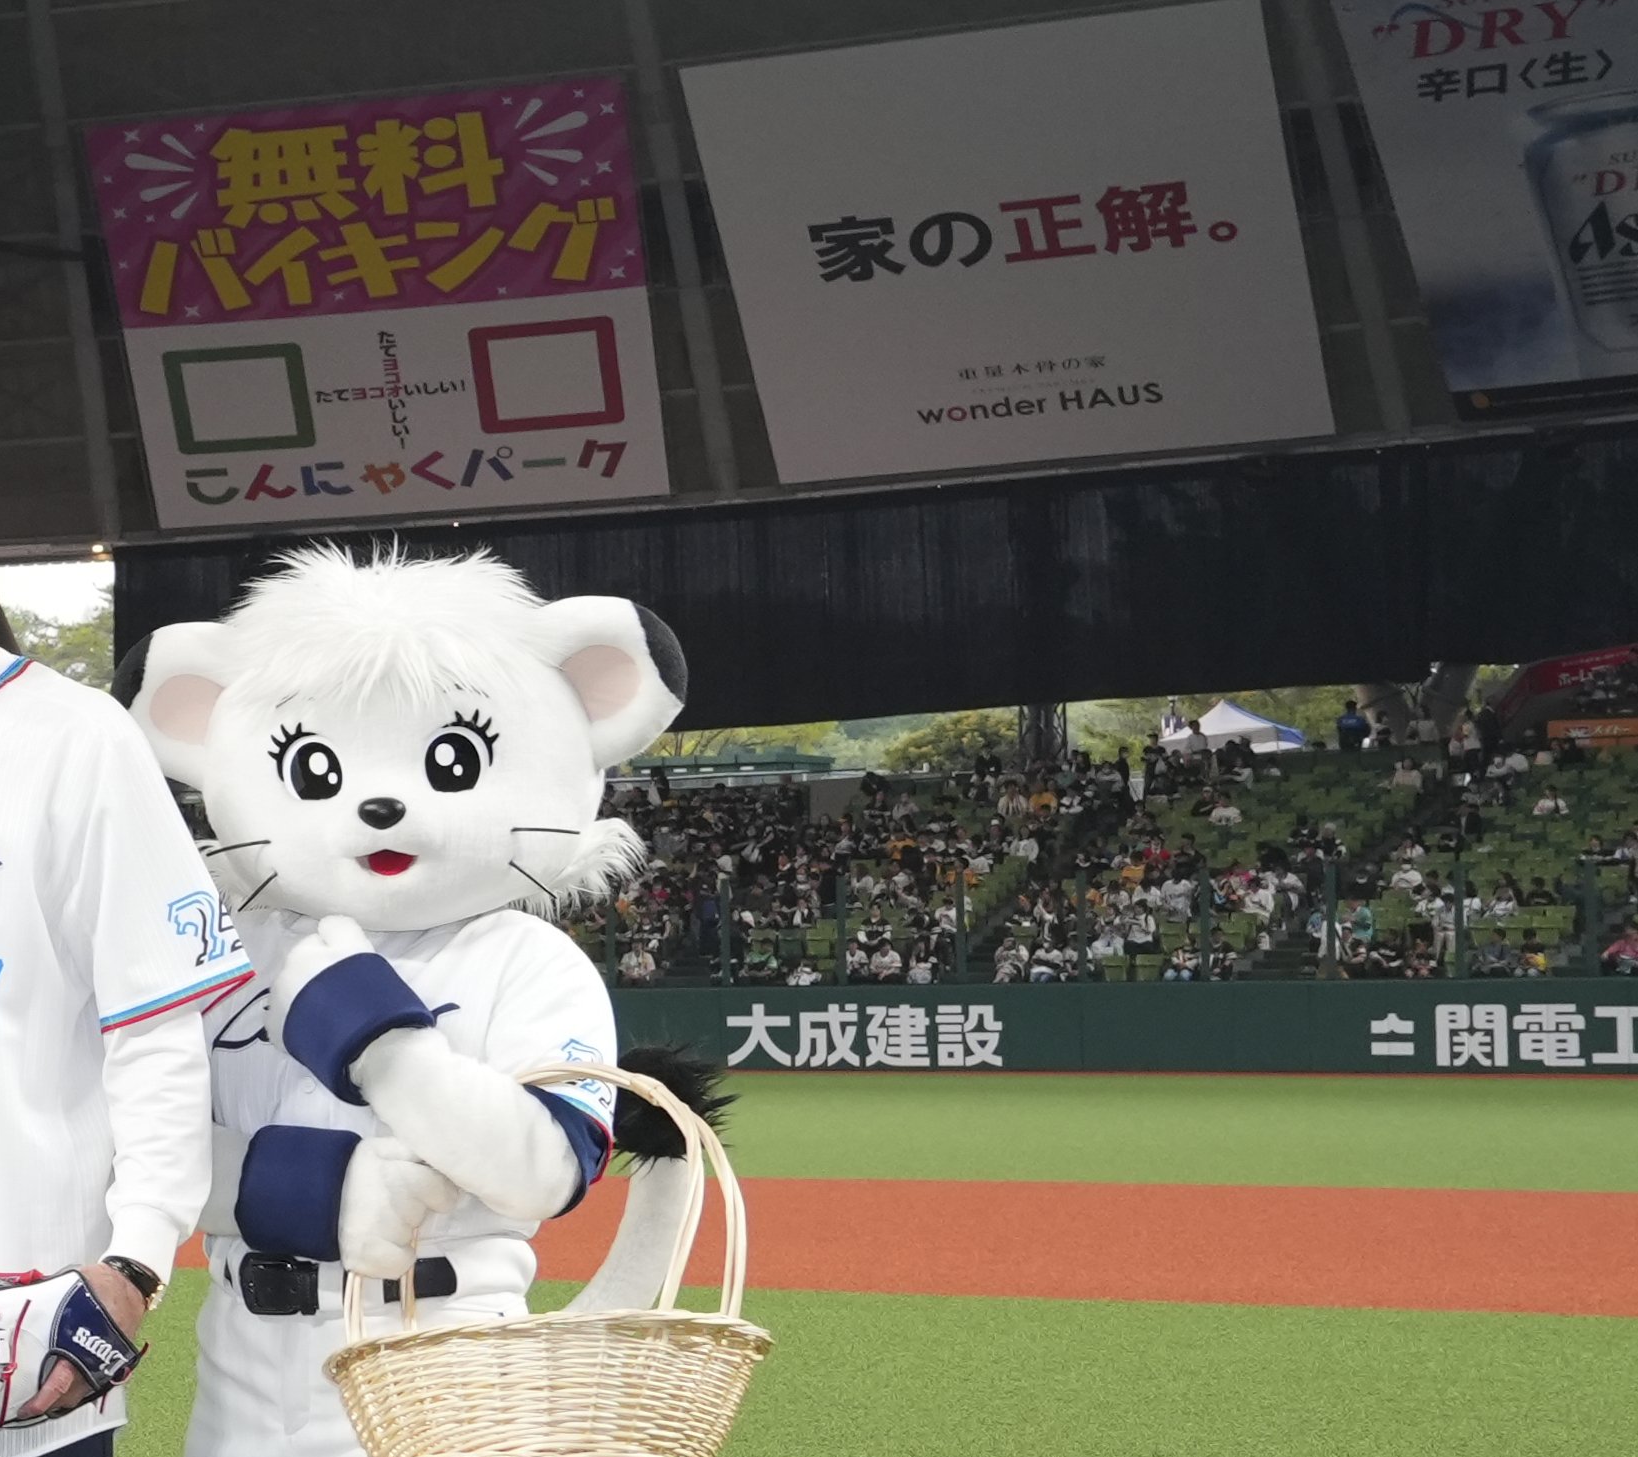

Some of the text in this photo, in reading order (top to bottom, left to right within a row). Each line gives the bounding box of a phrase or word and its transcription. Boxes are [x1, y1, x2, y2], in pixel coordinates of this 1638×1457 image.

[210, 112, 505, 229] 無料
[140, 196, 617, 316] バイキング
[807, 181, 1239, 283] 家の正解。
[917, 382, 1164, 426] wonder HAUS
[725, 1003, 1004, 1069] 大成建設
